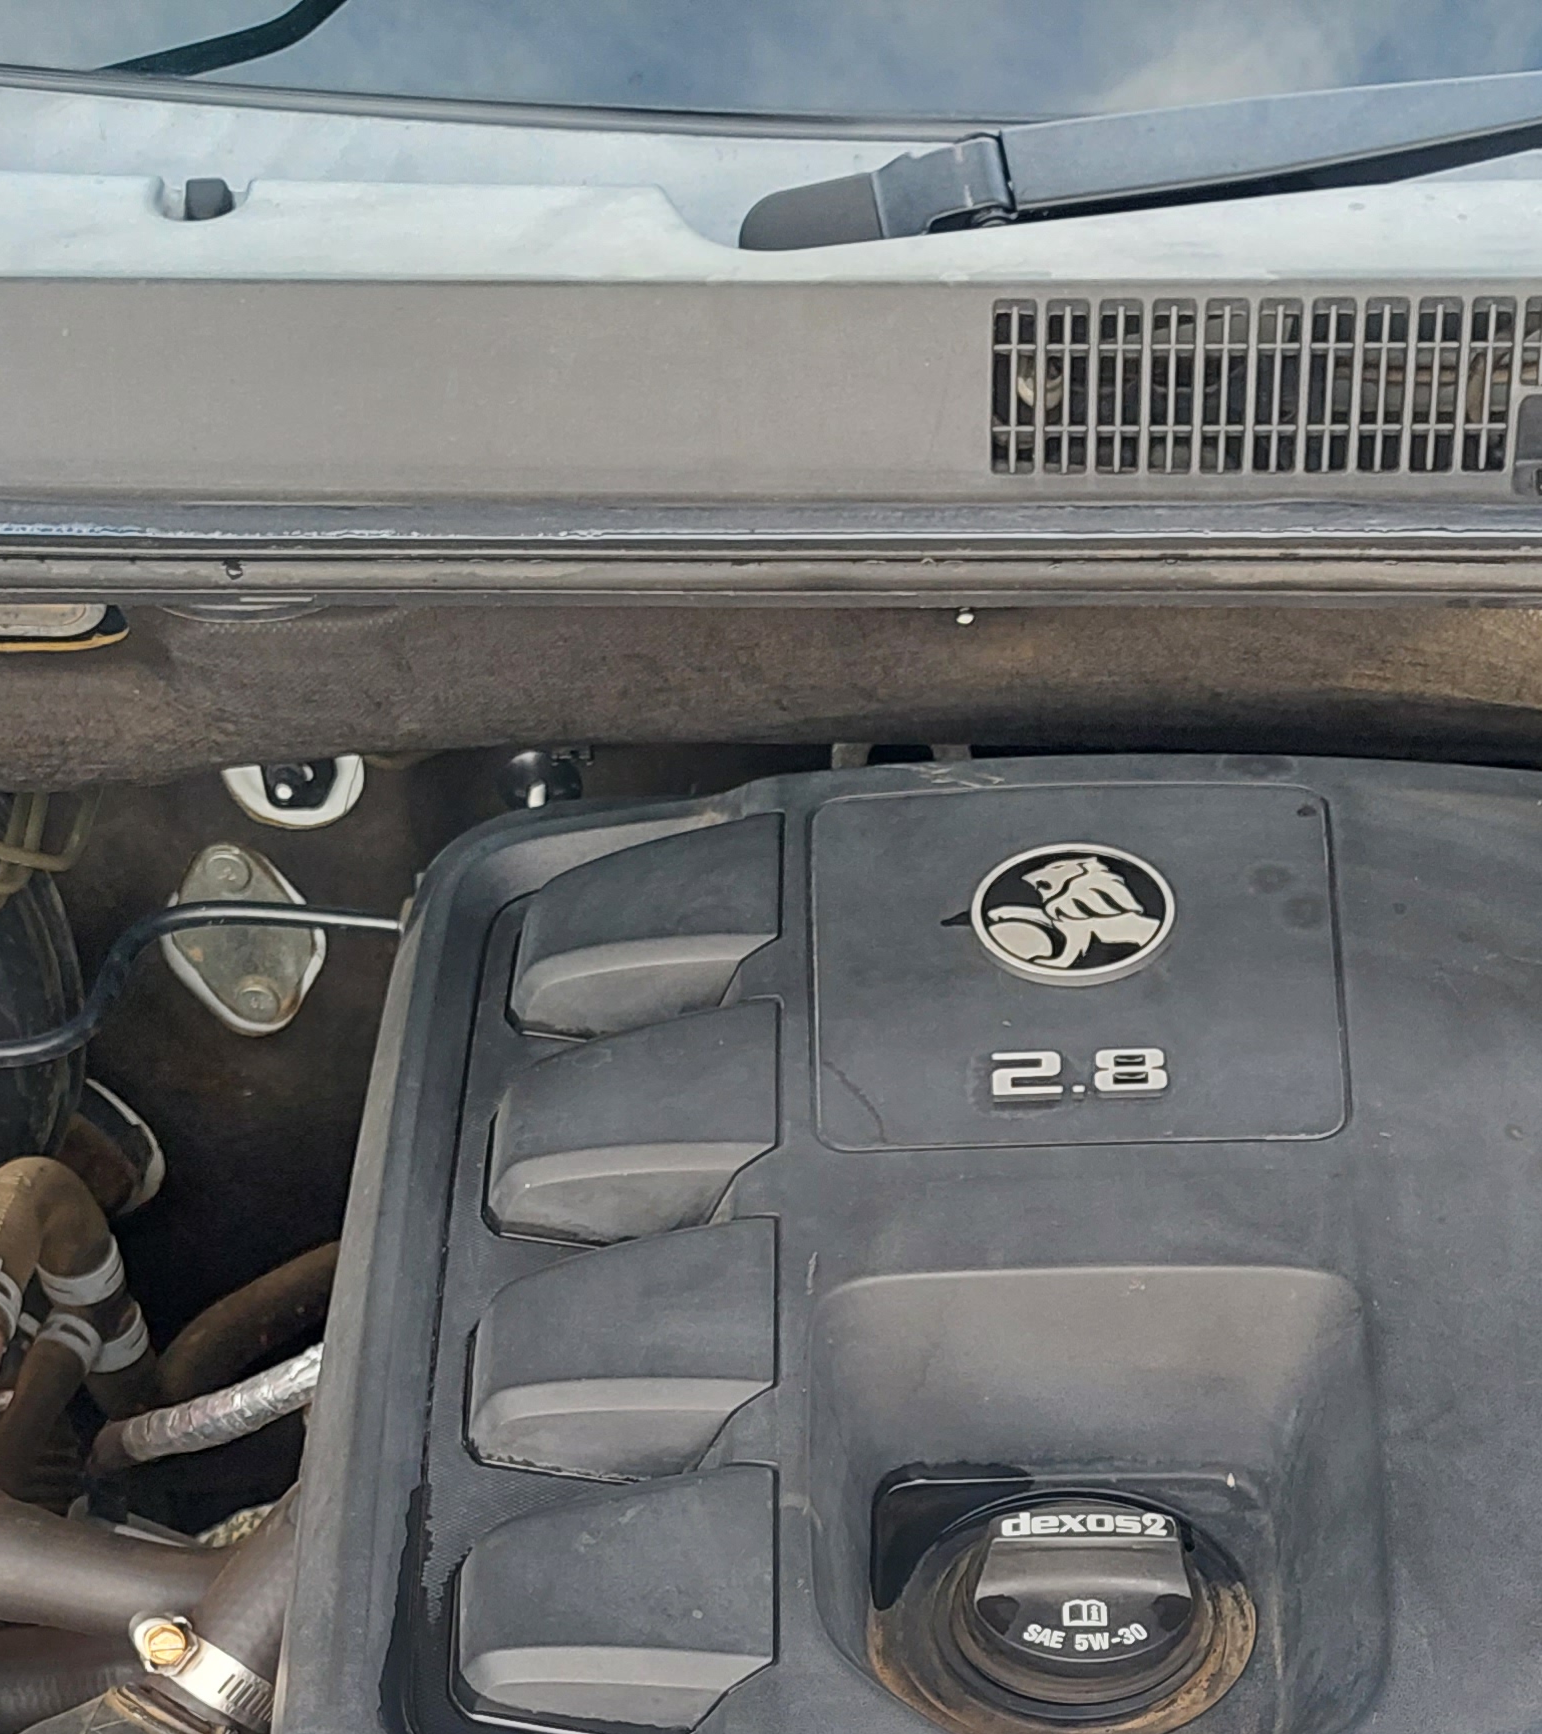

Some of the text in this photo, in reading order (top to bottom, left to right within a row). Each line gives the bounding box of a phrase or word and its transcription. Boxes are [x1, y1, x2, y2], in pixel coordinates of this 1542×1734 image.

[989, 1047, 1169, 1103] 2.8
[1000, 1511, 1170, 1539] dexos2
[1023, 1623, 1149, 1652] SAE 5W-30
